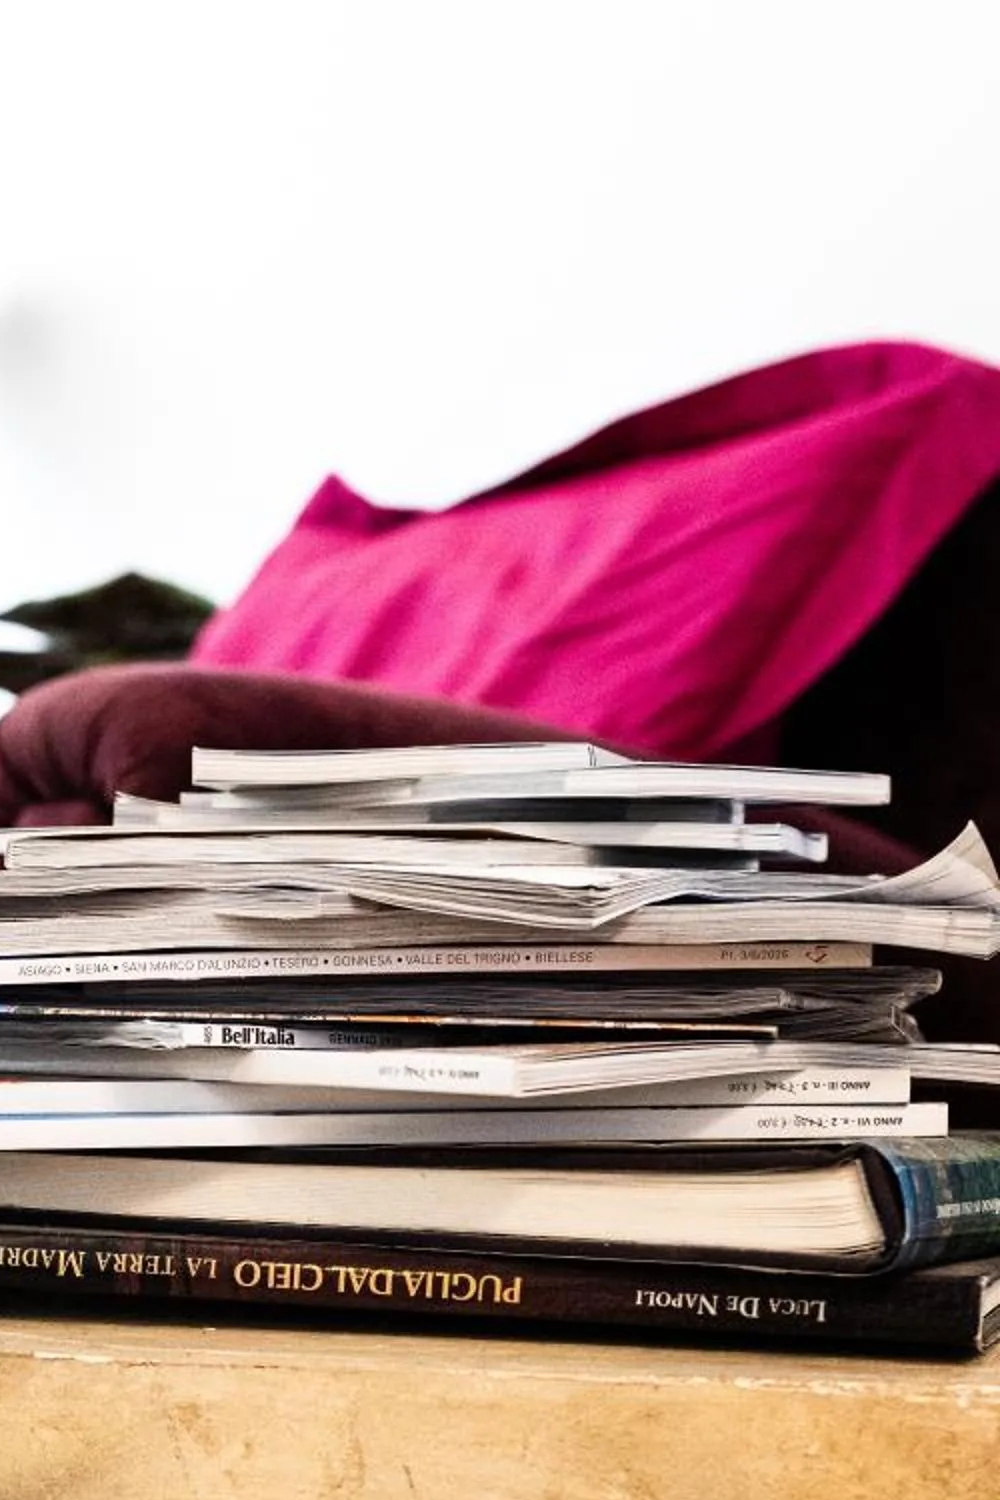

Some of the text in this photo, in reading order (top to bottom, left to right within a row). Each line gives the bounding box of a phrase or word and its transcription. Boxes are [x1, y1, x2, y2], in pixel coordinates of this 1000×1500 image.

[122, 961, 147, 973] SAN
[150, 959, 195, 972] MARCO
[334, 954, 393, 967] GONNESA
[406, 953, 444, 966] VALLE
[447, 953, 471, 965] DEL
[474, 952, 521, 965] TRIGNO
[535, 951, 594, 964] BIELLESE
[222, 1026, 296, 1046] Bell'Italia
[841, 1080, 870, 1090] ANNO
[874, 1117, 904, 1127] ANNO
[96, 1250, 176, 1277] TERRA
[186, 1256, 217, 1280] LA
[233, 1259, 325, 1292] CIELO
[335, 1265, 394, 1297] DAL
[403, 1269, 522, 1306] PUGLIA
[635, 1289, 720, 1316] NAPOLI
[768, 1296, 827, 1322] LUCA
